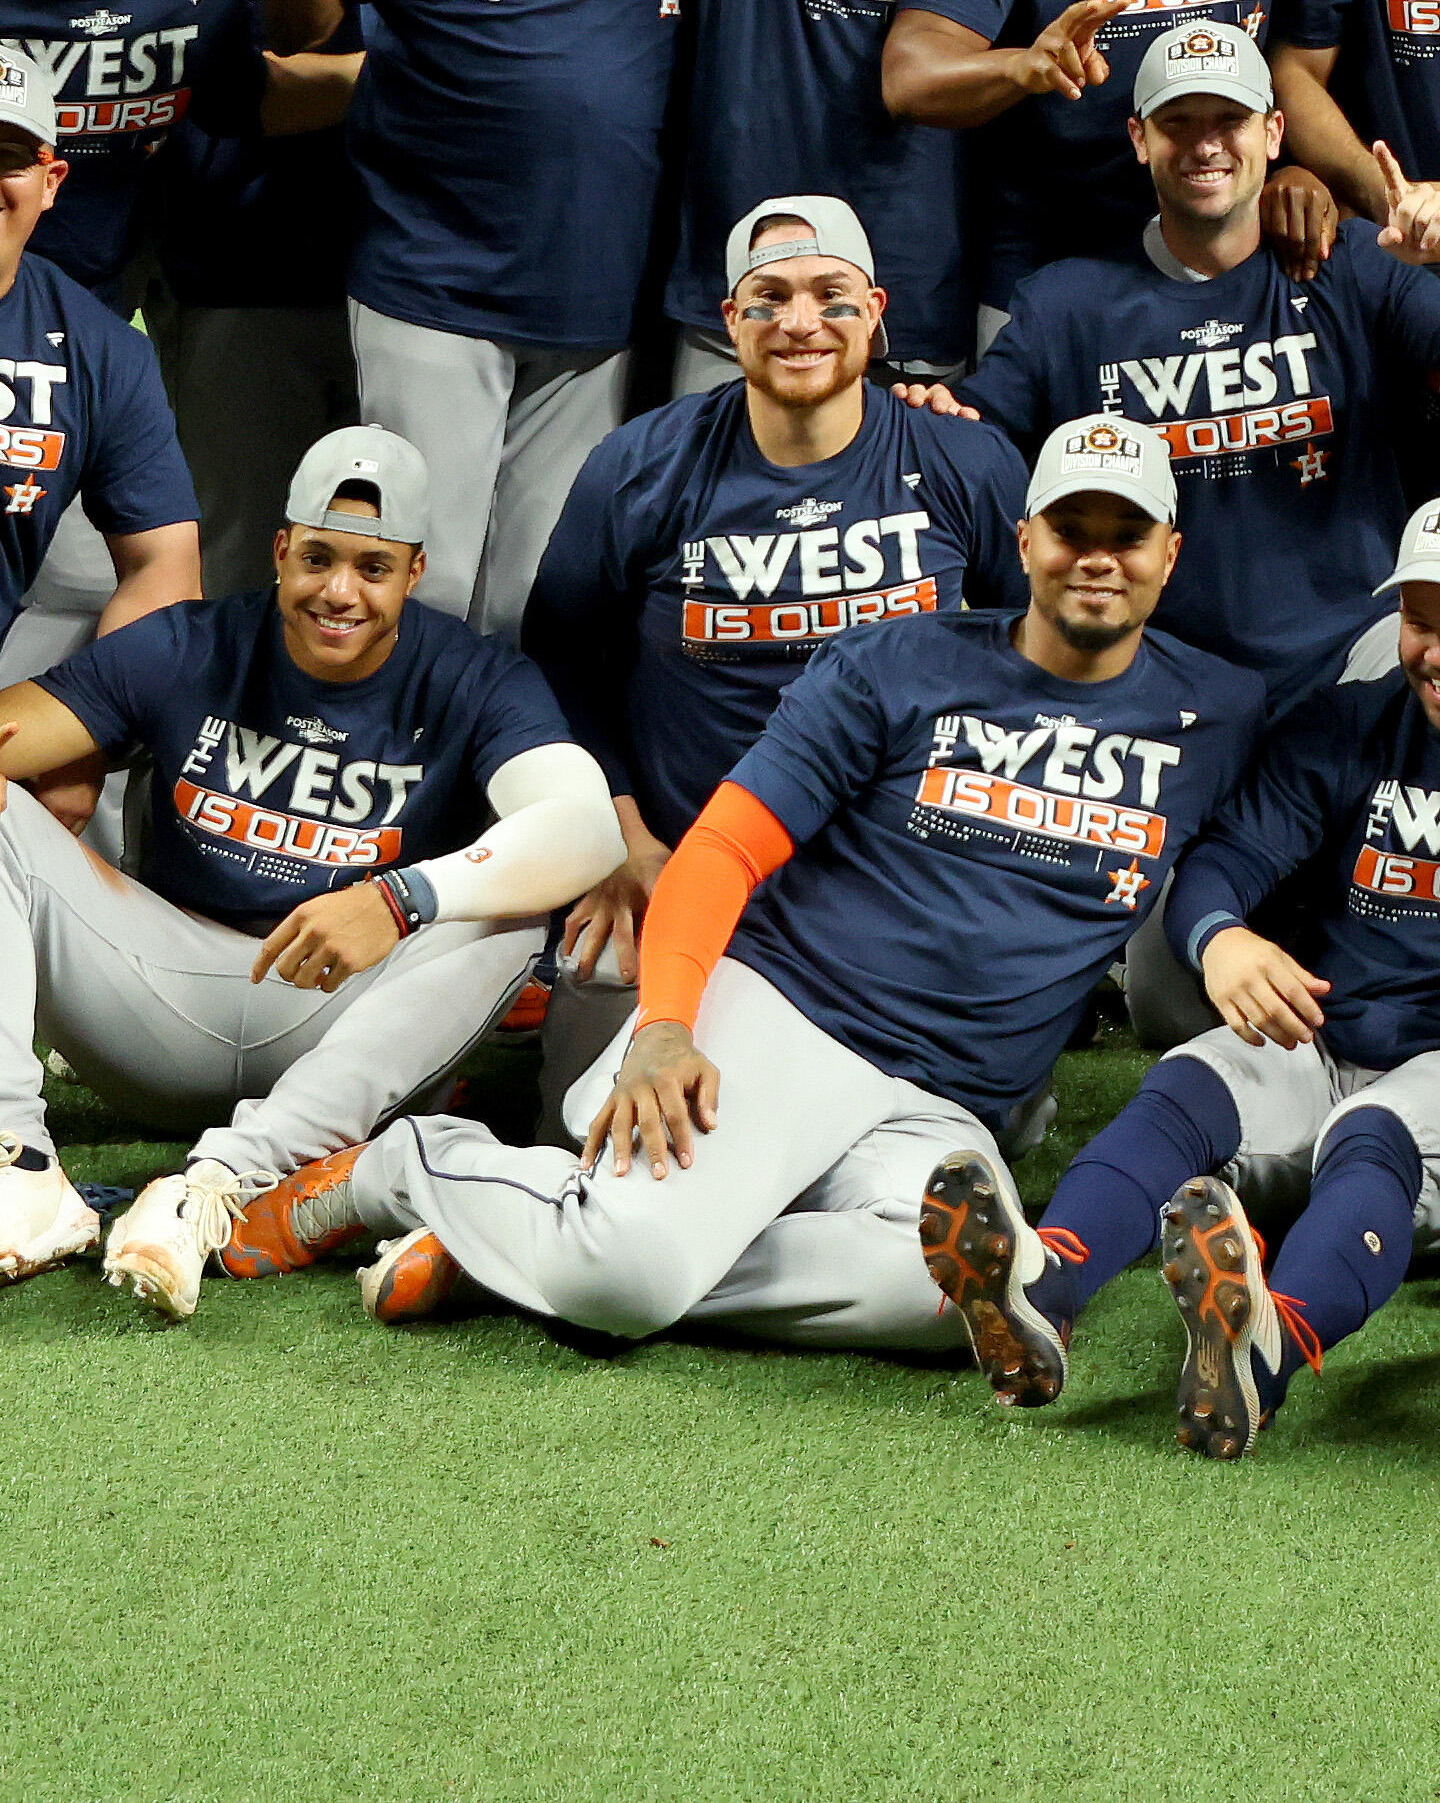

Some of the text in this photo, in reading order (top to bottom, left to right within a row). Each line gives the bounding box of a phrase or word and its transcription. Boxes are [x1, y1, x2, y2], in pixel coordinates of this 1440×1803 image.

[1404, 0, 1440, 31] IS
[286, 716, 349, 743] POSTSEASON
[181, 716, 423, 824] THE WEST
[188, 792, 381, 863] IS OURS
